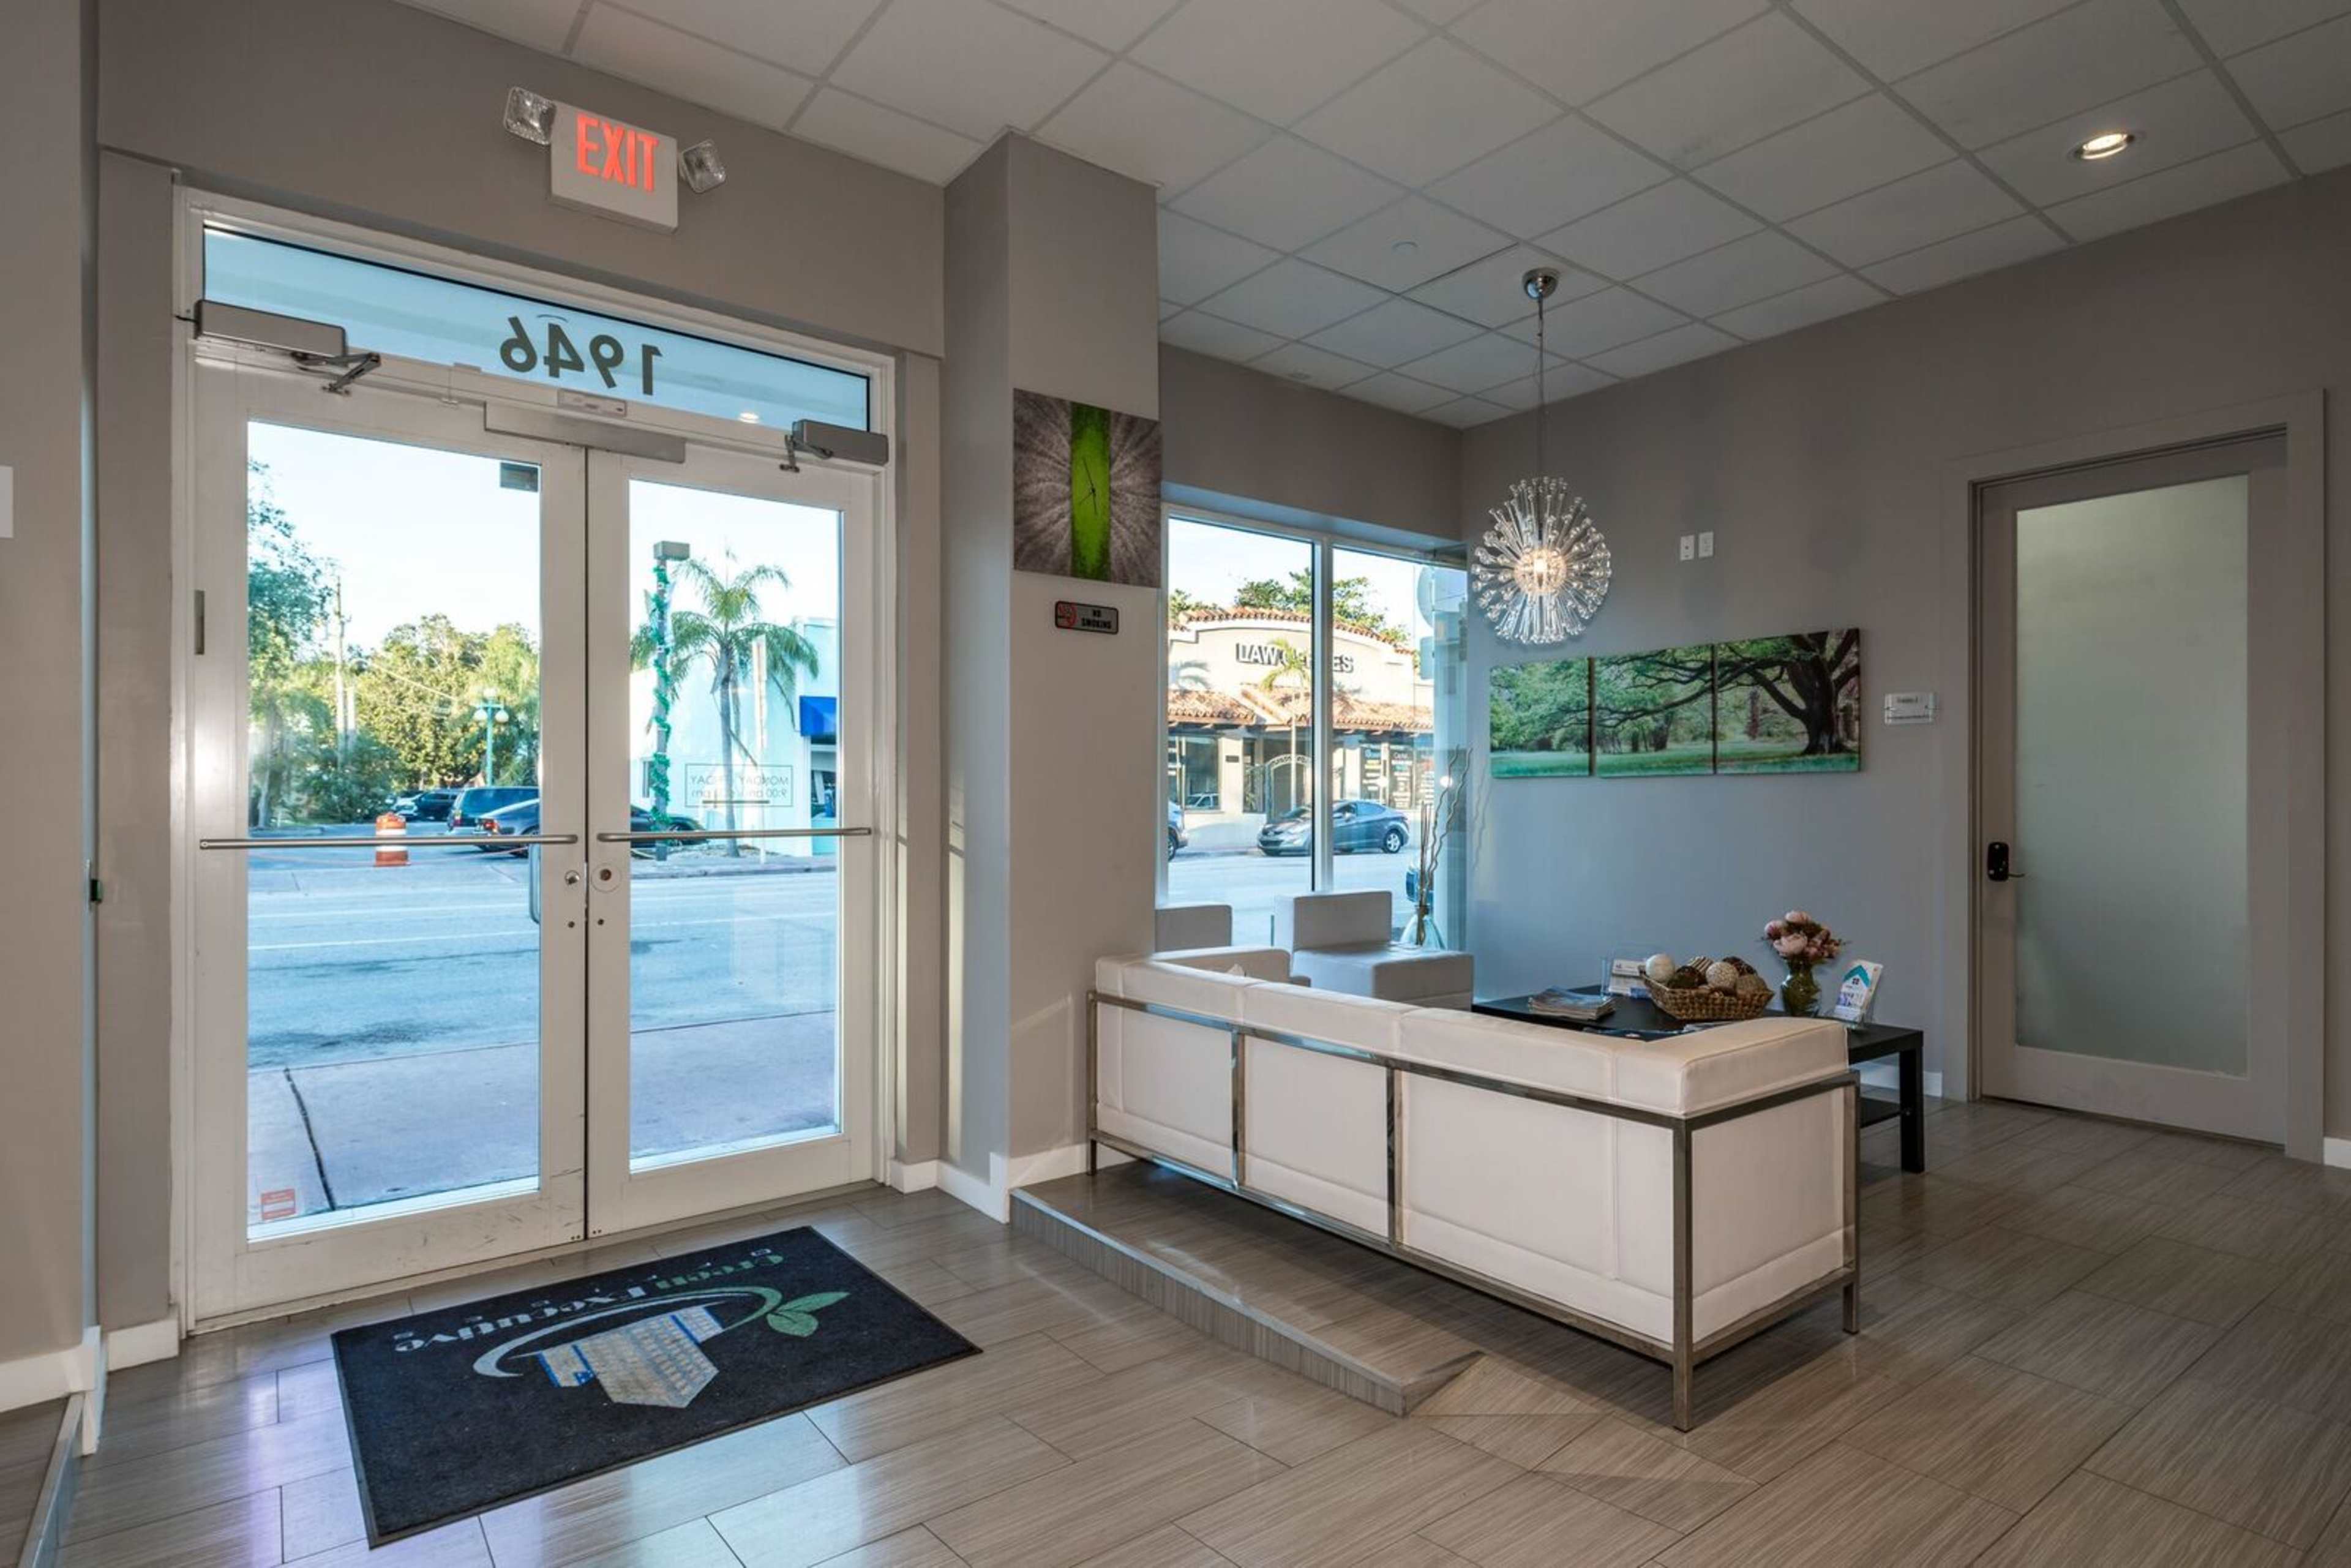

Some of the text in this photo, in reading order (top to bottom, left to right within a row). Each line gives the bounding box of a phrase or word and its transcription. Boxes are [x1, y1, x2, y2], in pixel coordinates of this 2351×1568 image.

[577, 112, 659, 193] EXIT
[1092, 609, 1101, 618] NO
[1081, 617, 1112, 629] SMOKING
[1235, 643, 1279, 666] LAW
